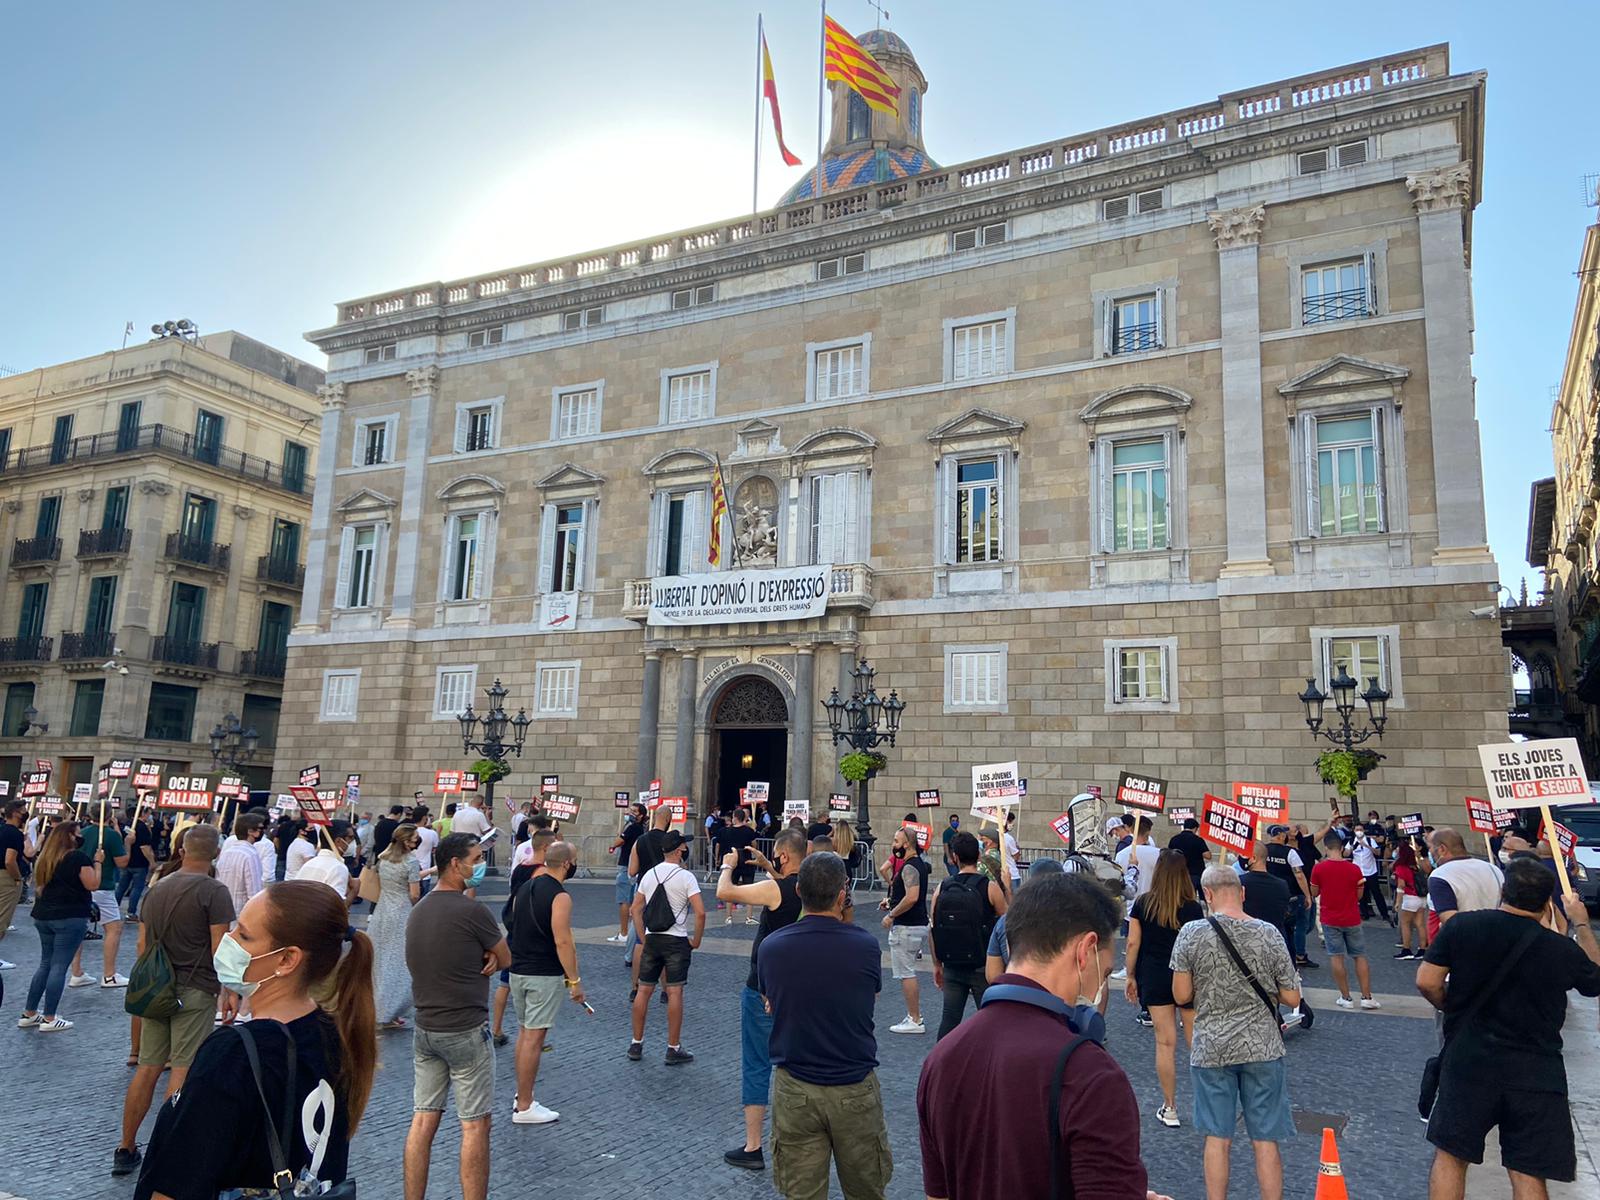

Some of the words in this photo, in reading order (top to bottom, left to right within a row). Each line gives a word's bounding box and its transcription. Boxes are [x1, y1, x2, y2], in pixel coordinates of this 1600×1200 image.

[701, 577, 746, 606] D'OPINIÓ
[758, 572, 825, 603] D'EXPRESSIÓ
[687, 609, 693, 617] DE
[733, 606, 758, 614] UNIVERSAL
[760, 605, 771, 613] DELS
[773, 604, 788, 612] DRETS
[789, 603, 811, 611] HUMANS
[704, 667, 721, 685] PALAU
[721, 661, 731, 670] DE
[731, 657, 740, 665] LA
[757, 656, 793, 682] GENERALITAT
[1498, 752, 1520, 767] ELS
[1524, 748, 1563, 765] JOVES
[980, 773, 990, 781] LOS
[991, 771, 1012, 781] JÓVENES
[1491, 767, 1531, 783] TENEN
[1533, 764, 1566, 779] DRET
[1569, 763, 1578, 777] A
[168, 776, 189, 791] OCI
[190, 777, 208, 792] EN
[976, 782, 995, 790] TIENEN
[1125, 776, 1147, 792] OCIO
[1148, 782, 1160, 794] EN
[1241, 785, 1280, 799] BOTELLÓN
[1495, 784, 1514, 799] UN
[1516, 782, 1538, 798] OCI
[1540, 779, 1581, 796] SEGUR
[161, 791, 209, 807] FALLIDA
[550, 794, 557, 802] EL
[1121, 788, 1160, 807] QUIEBRA
[1242, 795, 1253, 806] NO
[1266, 799, 1280, 809] OCI
[551, 810, 570, 820] SALUD
[1211, 800, 1251, 826] BOTELLÓN
[1209, 812, 1222, 827] NO
[1235, 822, 1249, 838] OCI
[1208, 825, 1246, 850] NOCTURN
